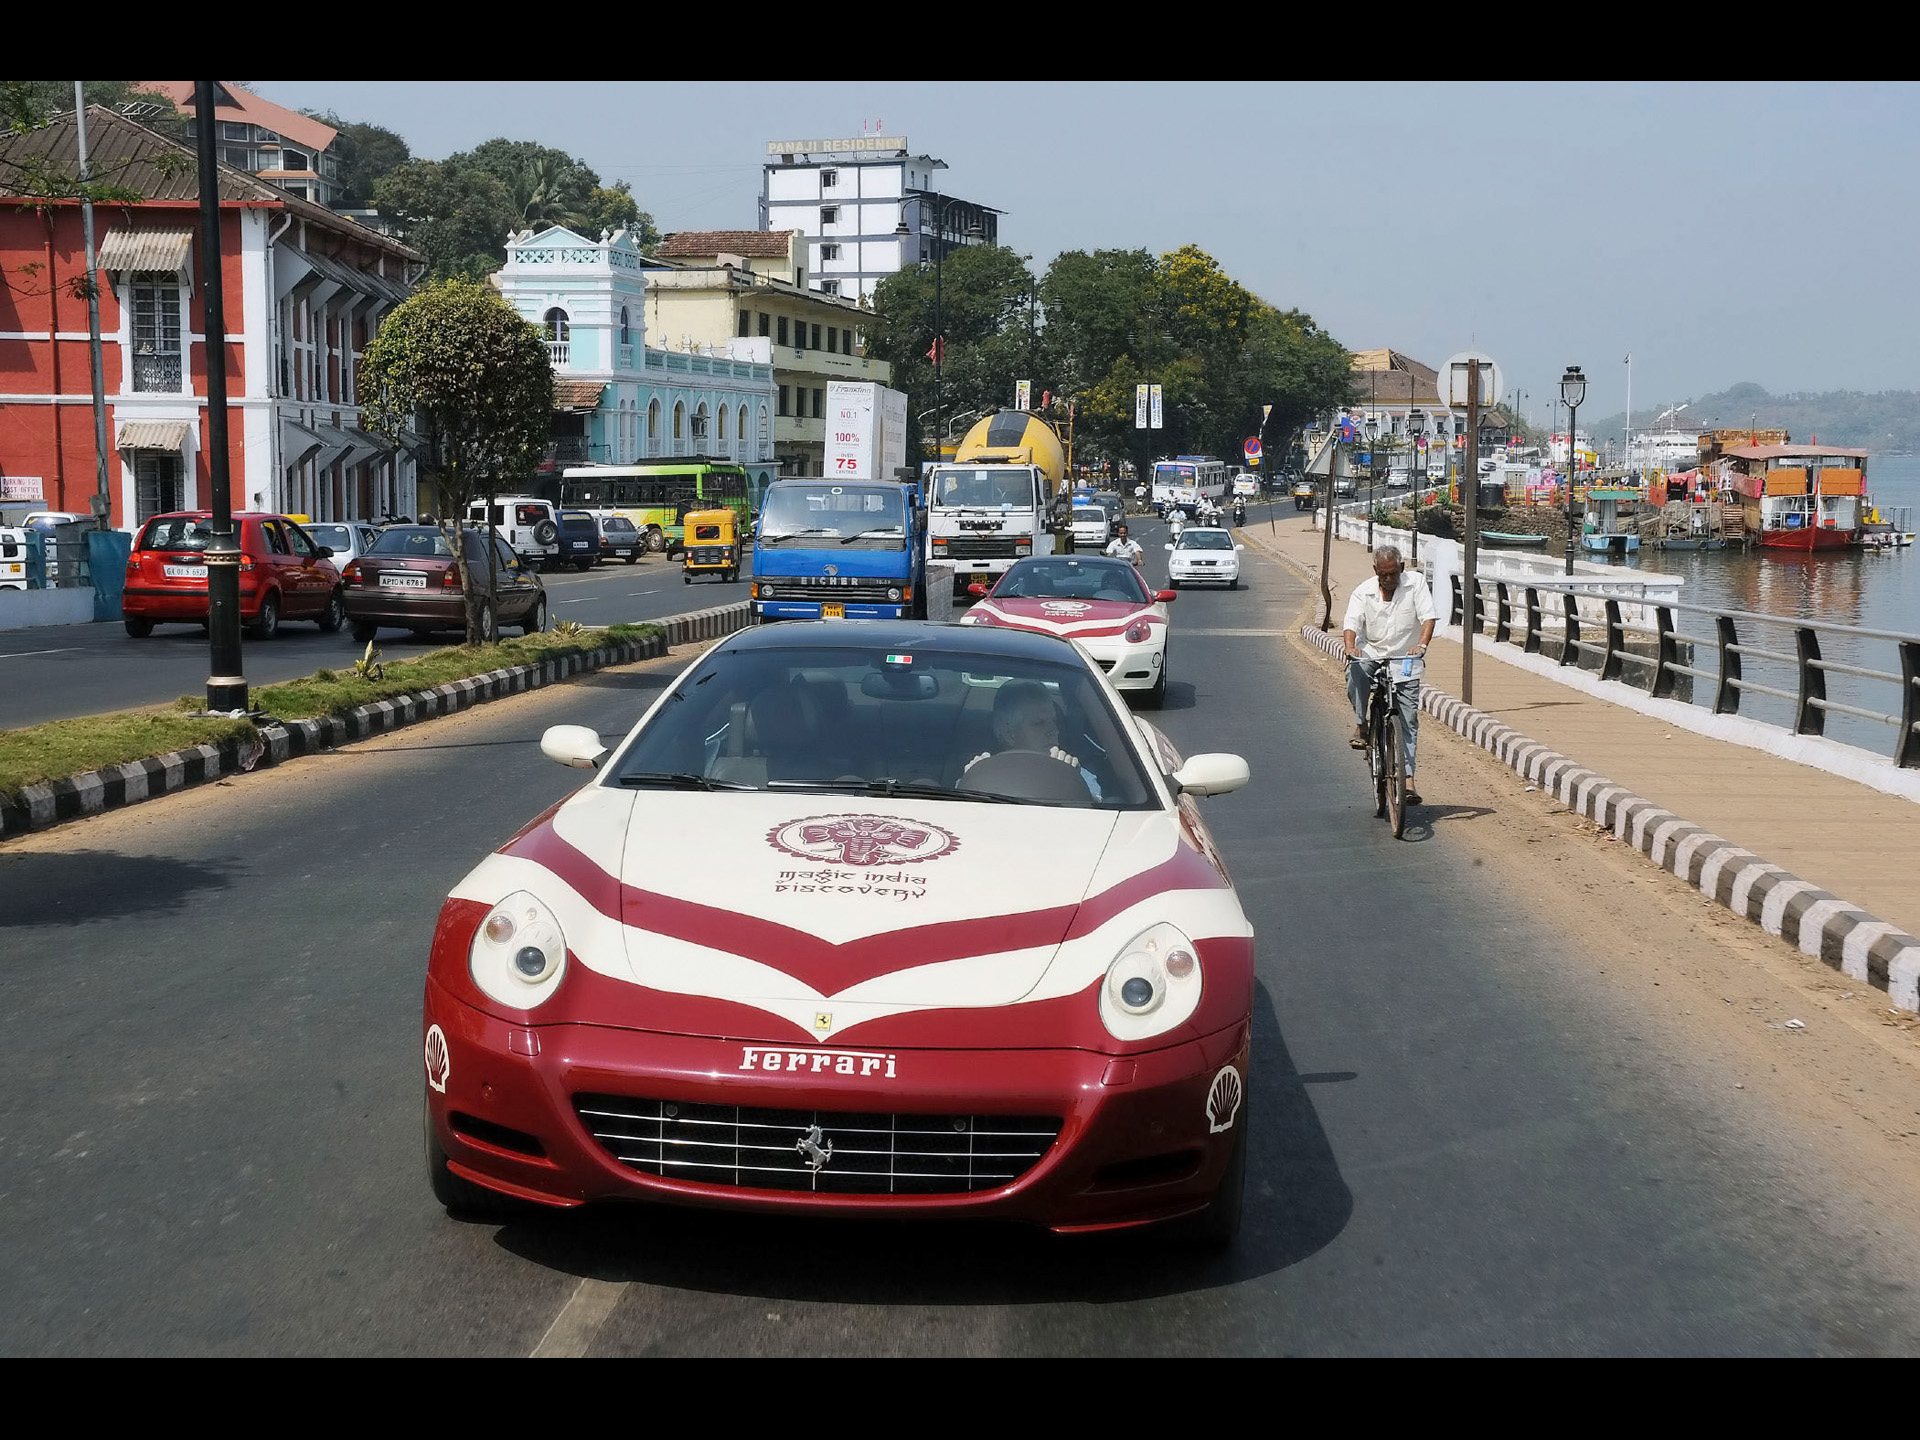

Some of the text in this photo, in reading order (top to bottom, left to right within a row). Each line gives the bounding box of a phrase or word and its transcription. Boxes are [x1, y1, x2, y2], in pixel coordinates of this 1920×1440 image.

[768, 141, 818, 154] PANAJI
[840, 410, 857, 419] NO.1
[835, 432, 860, 443] 100%
[835, 458, 857, 470] 75
[21, 486, 39, 494] OFFICE
[406, 579, 424, 587] 6789
[801, 576, 859, 586] EICHER
[738, 1046, 897, 1079] Ferrari
